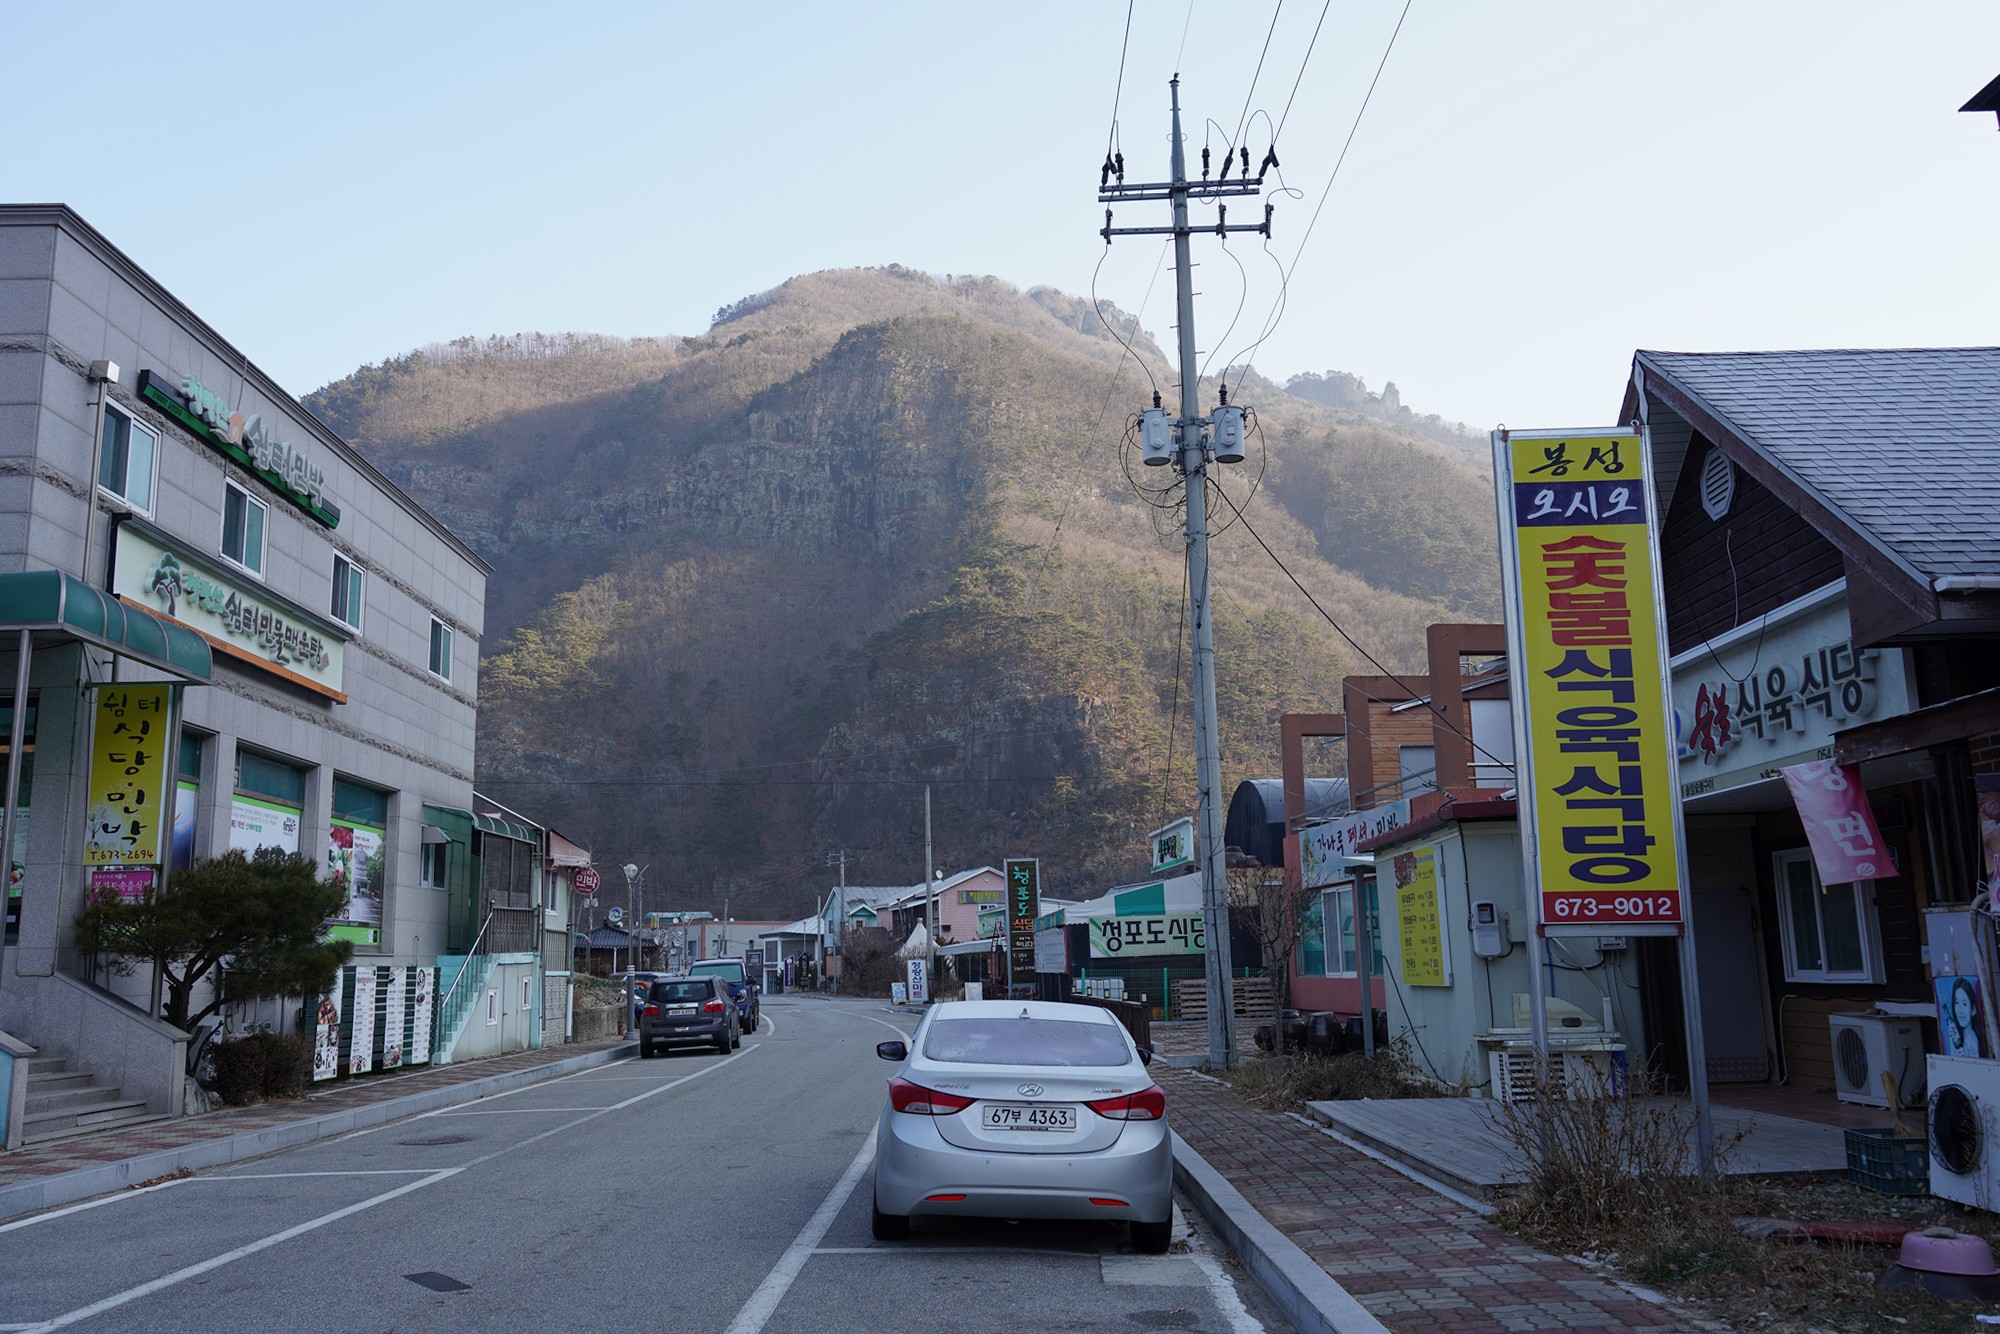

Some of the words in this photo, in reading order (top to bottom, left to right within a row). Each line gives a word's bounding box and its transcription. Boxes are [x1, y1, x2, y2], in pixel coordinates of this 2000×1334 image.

[245, 414, 325, 508] 쉼터민박
[1528, 441, 1625, 477] 봉성
[1527, 484, 1638, 520] 오시오
[225, 591, 324, 667] 쉼터민물매운탕
[103, 691, 161, 717] 쉼터
[1317, 830, 1344, 863] 강나루
[576, 873, 598, 889] 민박
[1013, 866, 1031, 917] 청포도
[1554, 896, 1674, 918] 673-9012
[911, 961, 924, 999] 청량산마트
[990, 1108, 1022, 1125] 67부
[1027, 1109, 1068, 1126] 4363
